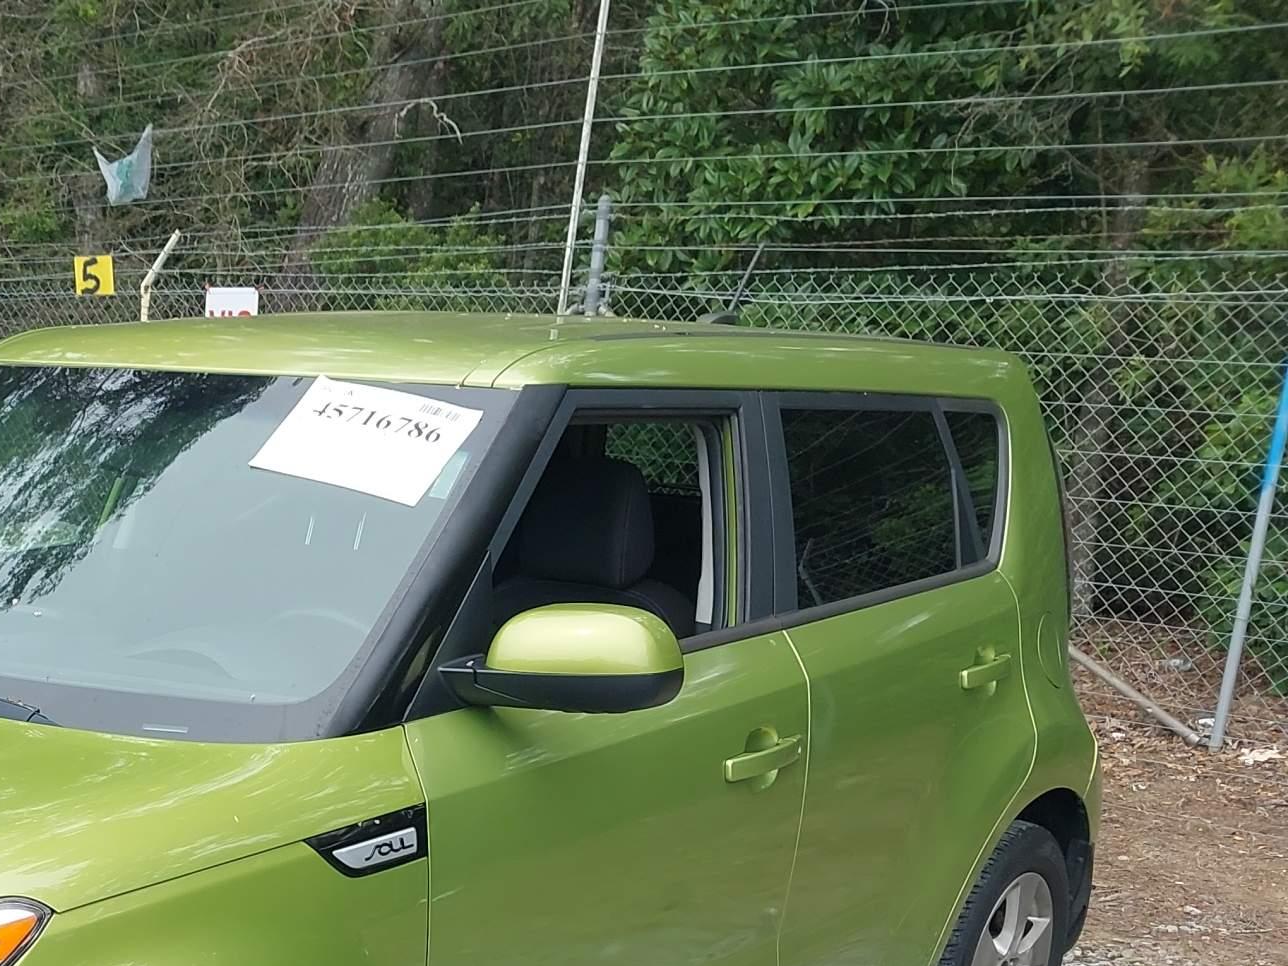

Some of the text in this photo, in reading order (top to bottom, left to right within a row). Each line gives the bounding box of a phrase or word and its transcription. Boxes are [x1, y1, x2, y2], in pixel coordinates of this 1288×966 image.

[81, 256, 101, 295] 5
[312, 402, 441, 442] 45716786
[364, 837, 414, 861] SOUL
